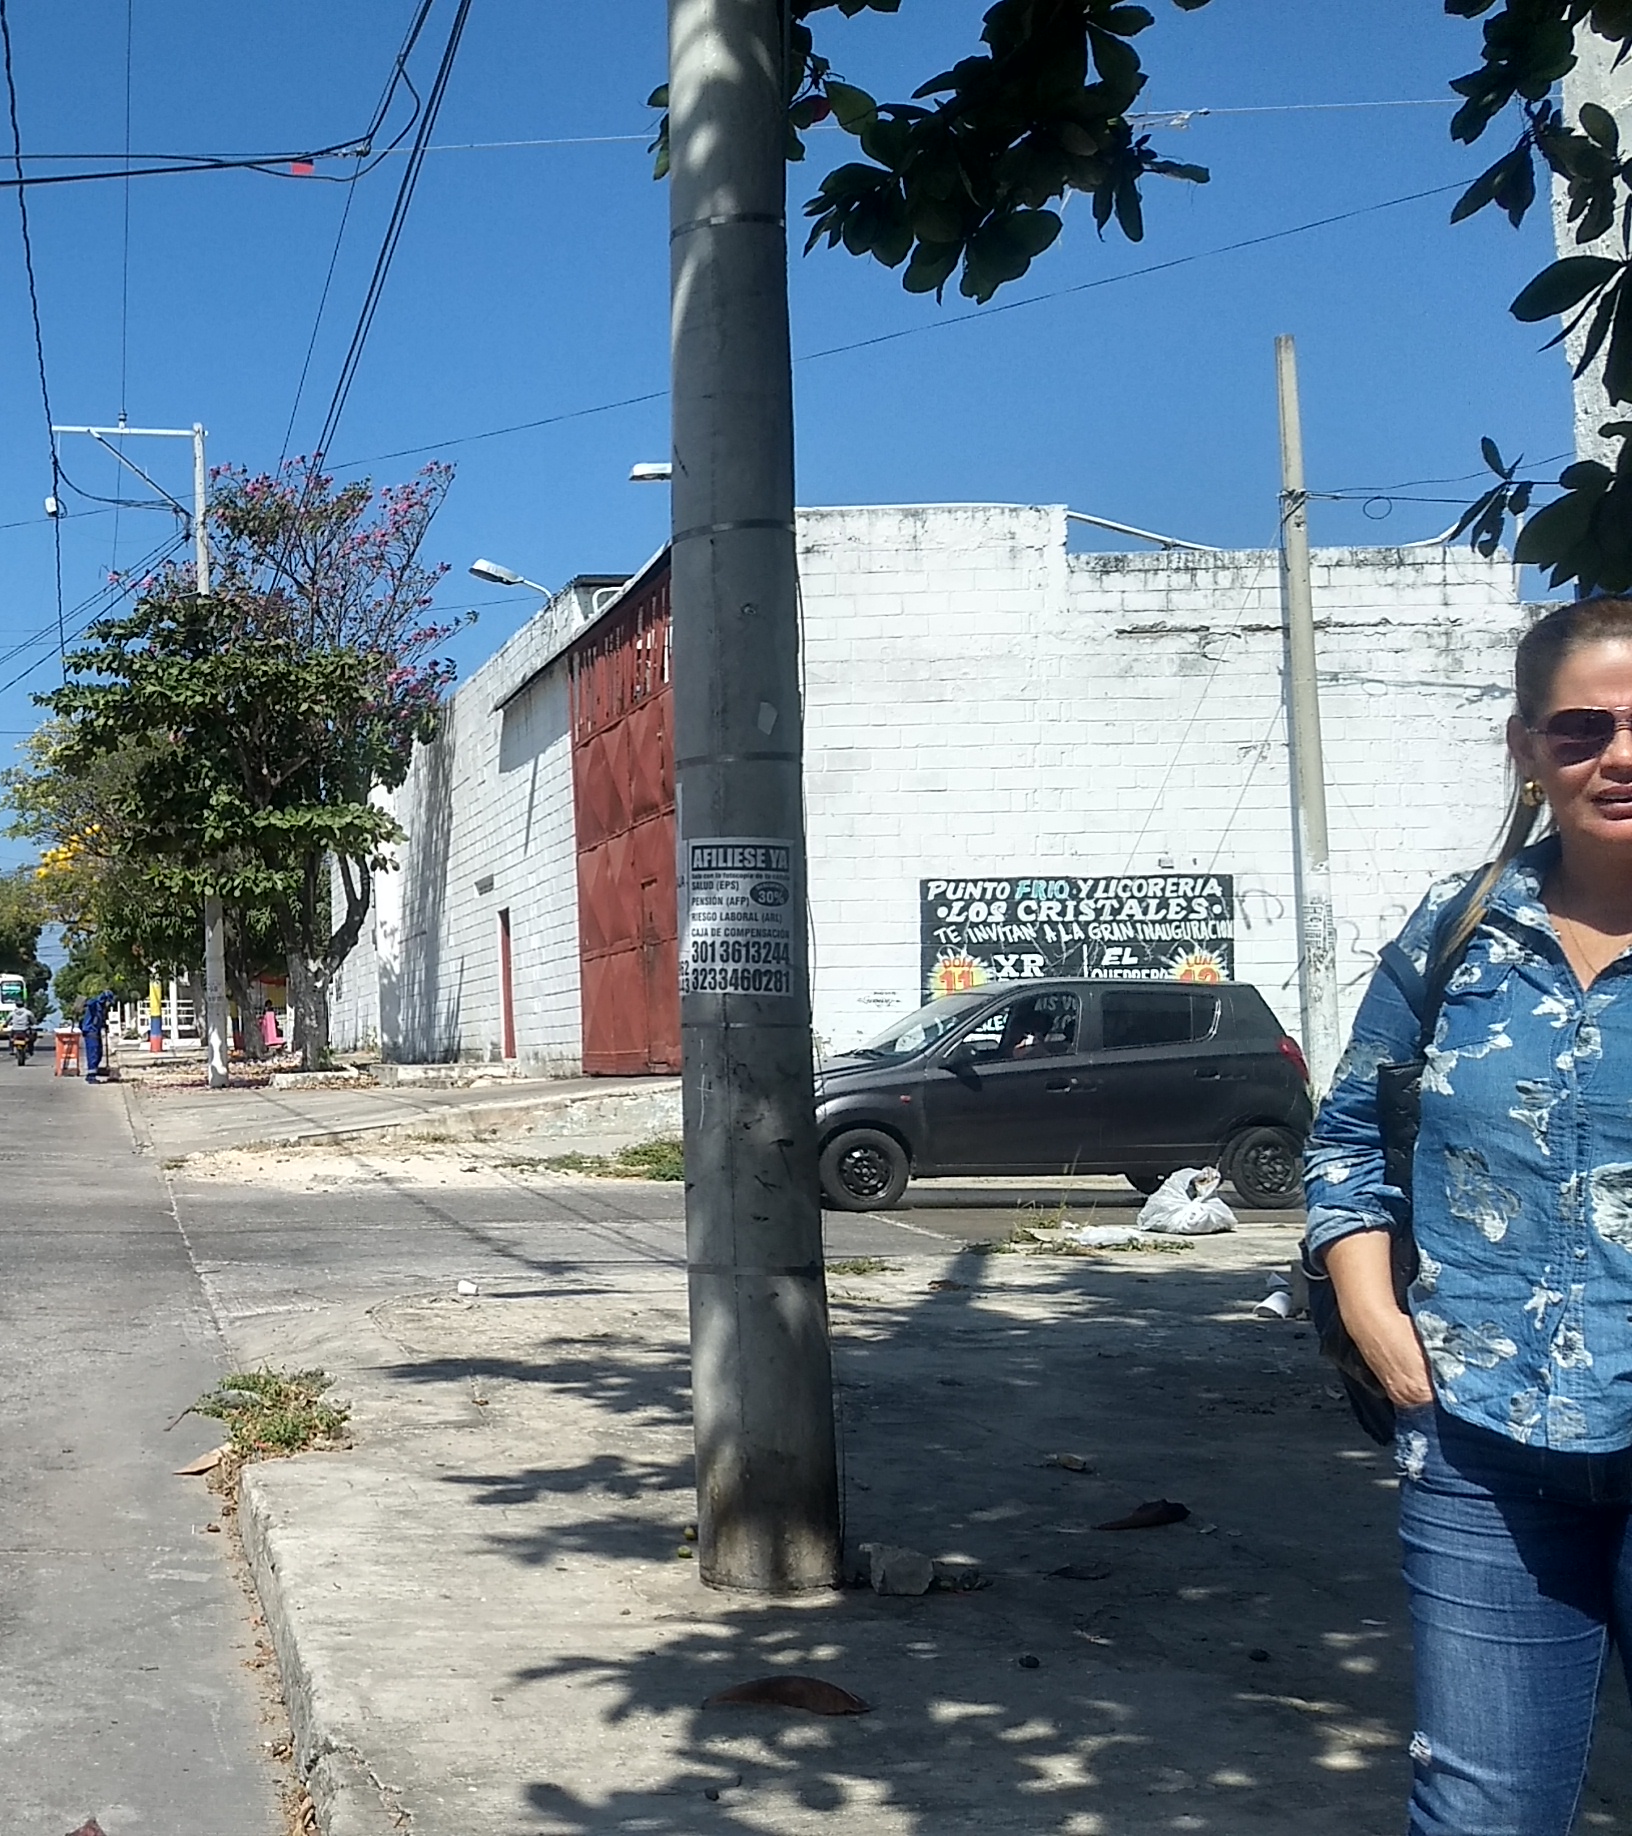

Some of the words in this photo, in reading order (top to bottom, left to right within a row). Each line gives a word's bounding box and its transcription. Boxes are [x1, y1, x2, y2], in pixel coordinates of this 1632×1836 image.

[693, 847, 766, 869] AFILIESE
[769, 849, 788, 869] YA
[692, 881, 714, 891] SALUD
[717, 880, 739, 892] (EPS)
[758, 890, 785, 904] 30%
[927, 880, 1010, 900] PUNTO
[1016, 879, 1068, 900] FRIO
[1094, 877, 1223, 898] LICORERIA
[726, 896, 750, 907] (AFP)
[946, 900, 1006, 923] LOS
[1017, 898, 1209, 922] CRISTALES
[692, 912, 717, 921] RIESGO
[720, 912, 759, 922] LABORAL
[692, 928, 709, 937] CAJA
[711, 928, 721, 937] DE
[934, 926, 962, 945] TE
[967, 923, 1036, 944] INVITAN
[1045, 923, 1057, 944] A
[1059, 921, 1085, 943] LA
[1088, 922, 1134, 942] GRAN
[692, 940, 716, 964] 301
[720, 940, 790, 965] 3613244
[1102, 947, 1138, 966] EL
[993, 953, 1045, 978] XR
[939, 970, 975, 995] 11
